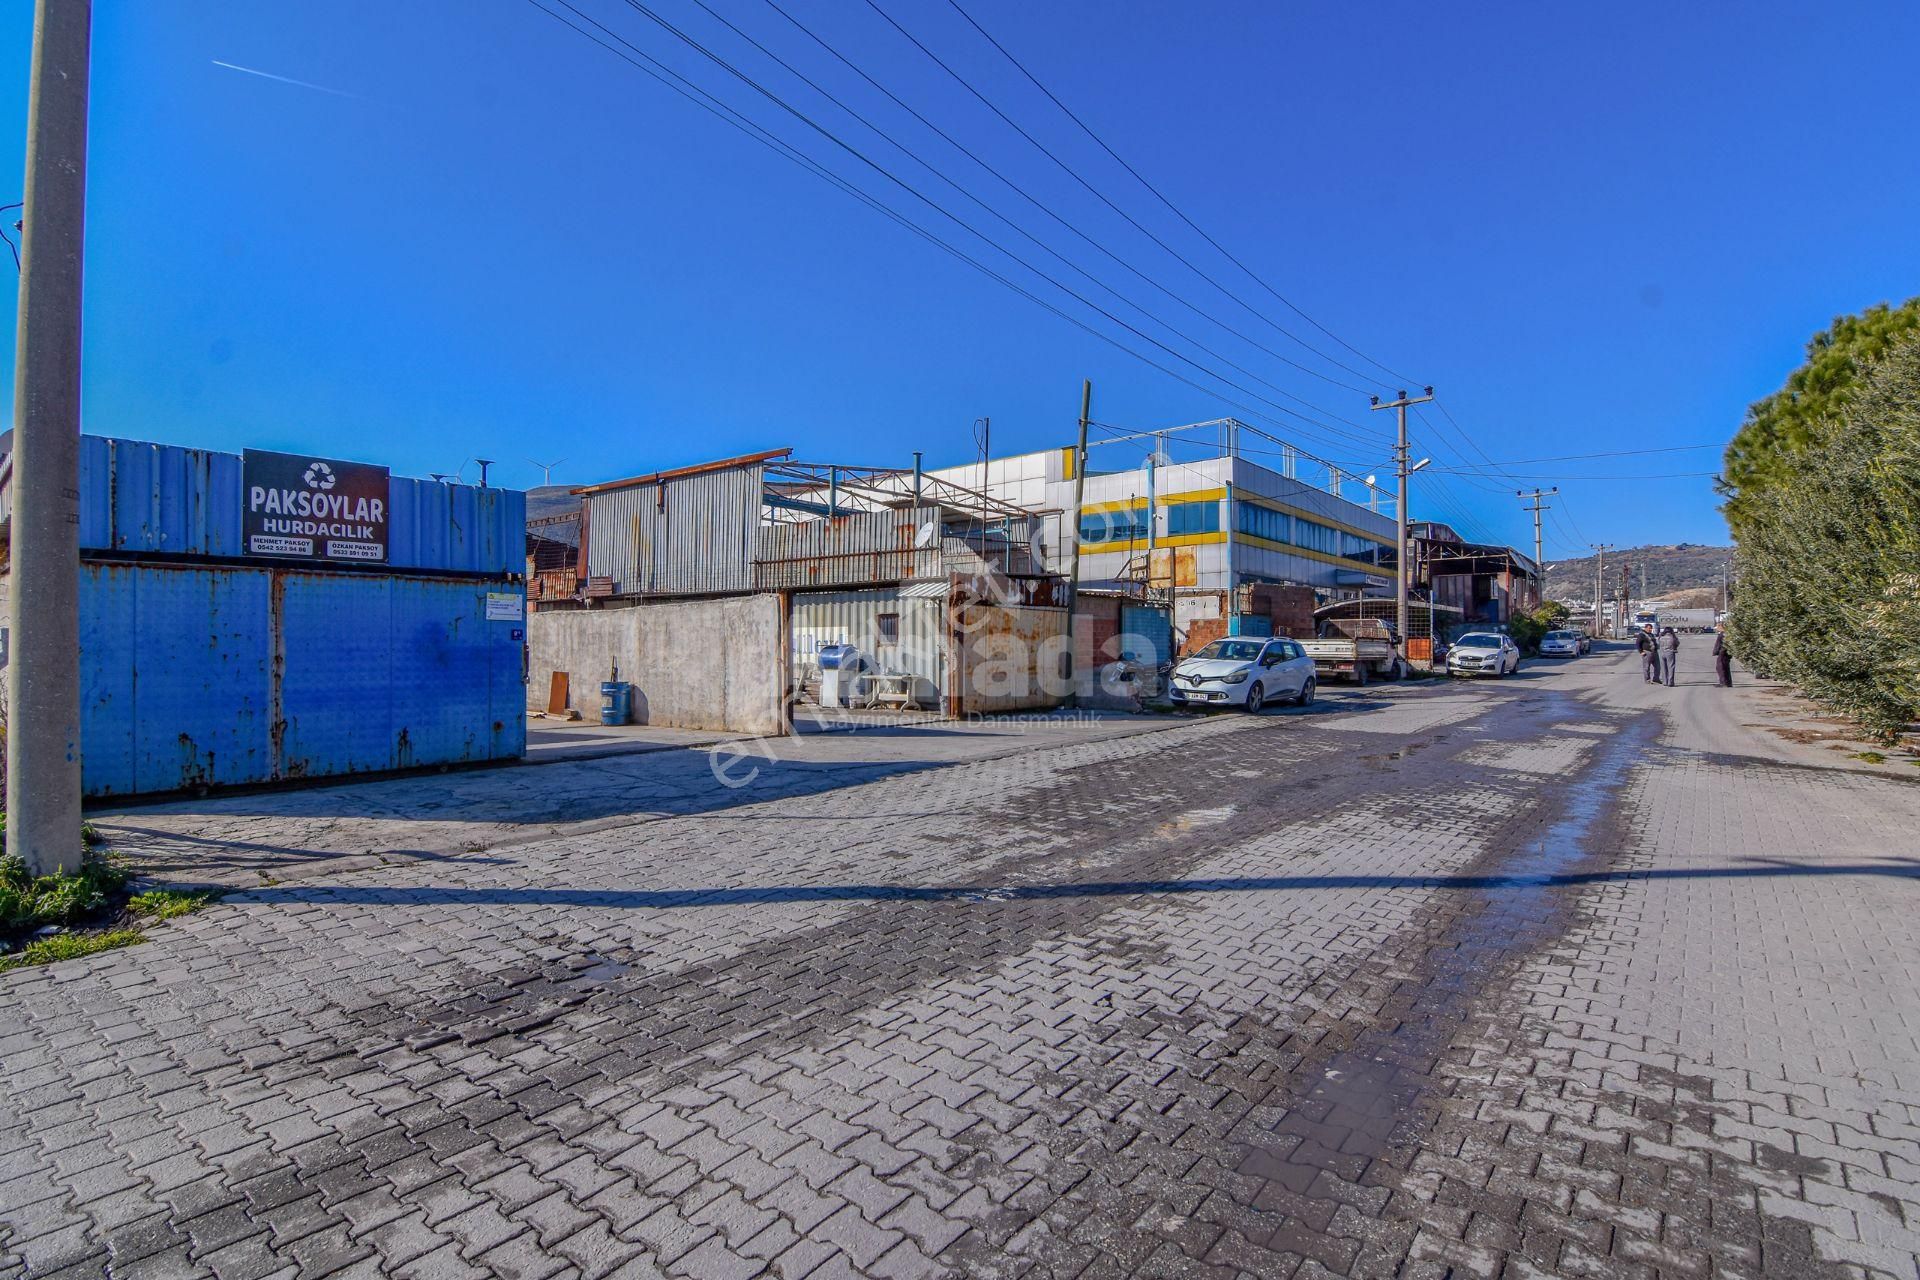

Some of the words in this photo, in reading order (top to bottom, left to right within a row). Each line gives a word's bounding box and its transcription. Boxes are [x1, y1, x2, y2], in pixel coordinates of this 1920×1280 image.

[251, 486, 384, 523] PAKSOYLAR
[263, 518, 374, 539] HURDACILIK
[253, 537, 282, 545] MEHMET
[284, 539, 310, 547] PAKSOY
